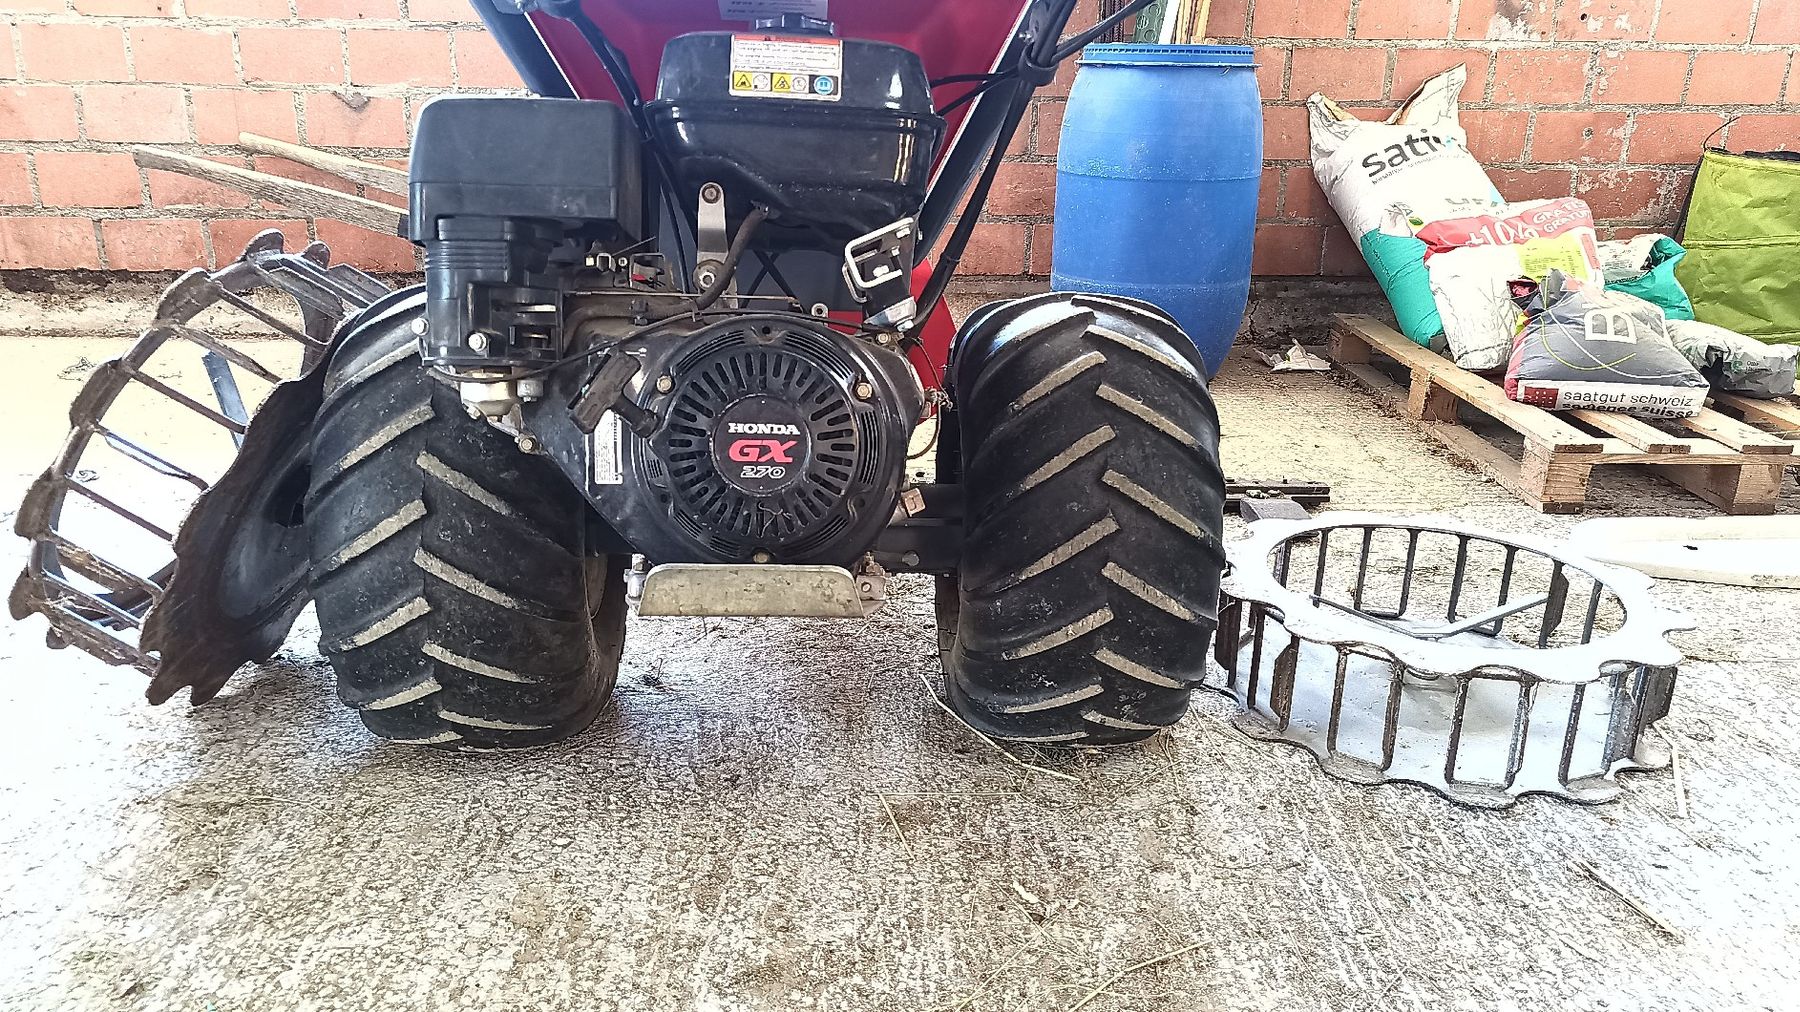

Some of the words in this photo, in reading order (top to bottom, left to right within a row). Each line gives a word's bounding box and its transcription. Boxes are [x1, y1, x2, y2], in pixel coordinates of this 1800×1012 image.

[1532, 200, 1588, 225] GRATIS
[1563, 391, 1626, 404] saatgut
[1630, 393, 1693, 407] schweiz
[1640, 406, 1694, 418] suisse
[728, 422, 800, 435] HONDA
[728, 439, 798, 463] GX
[740, 465, 785, 479] 270
